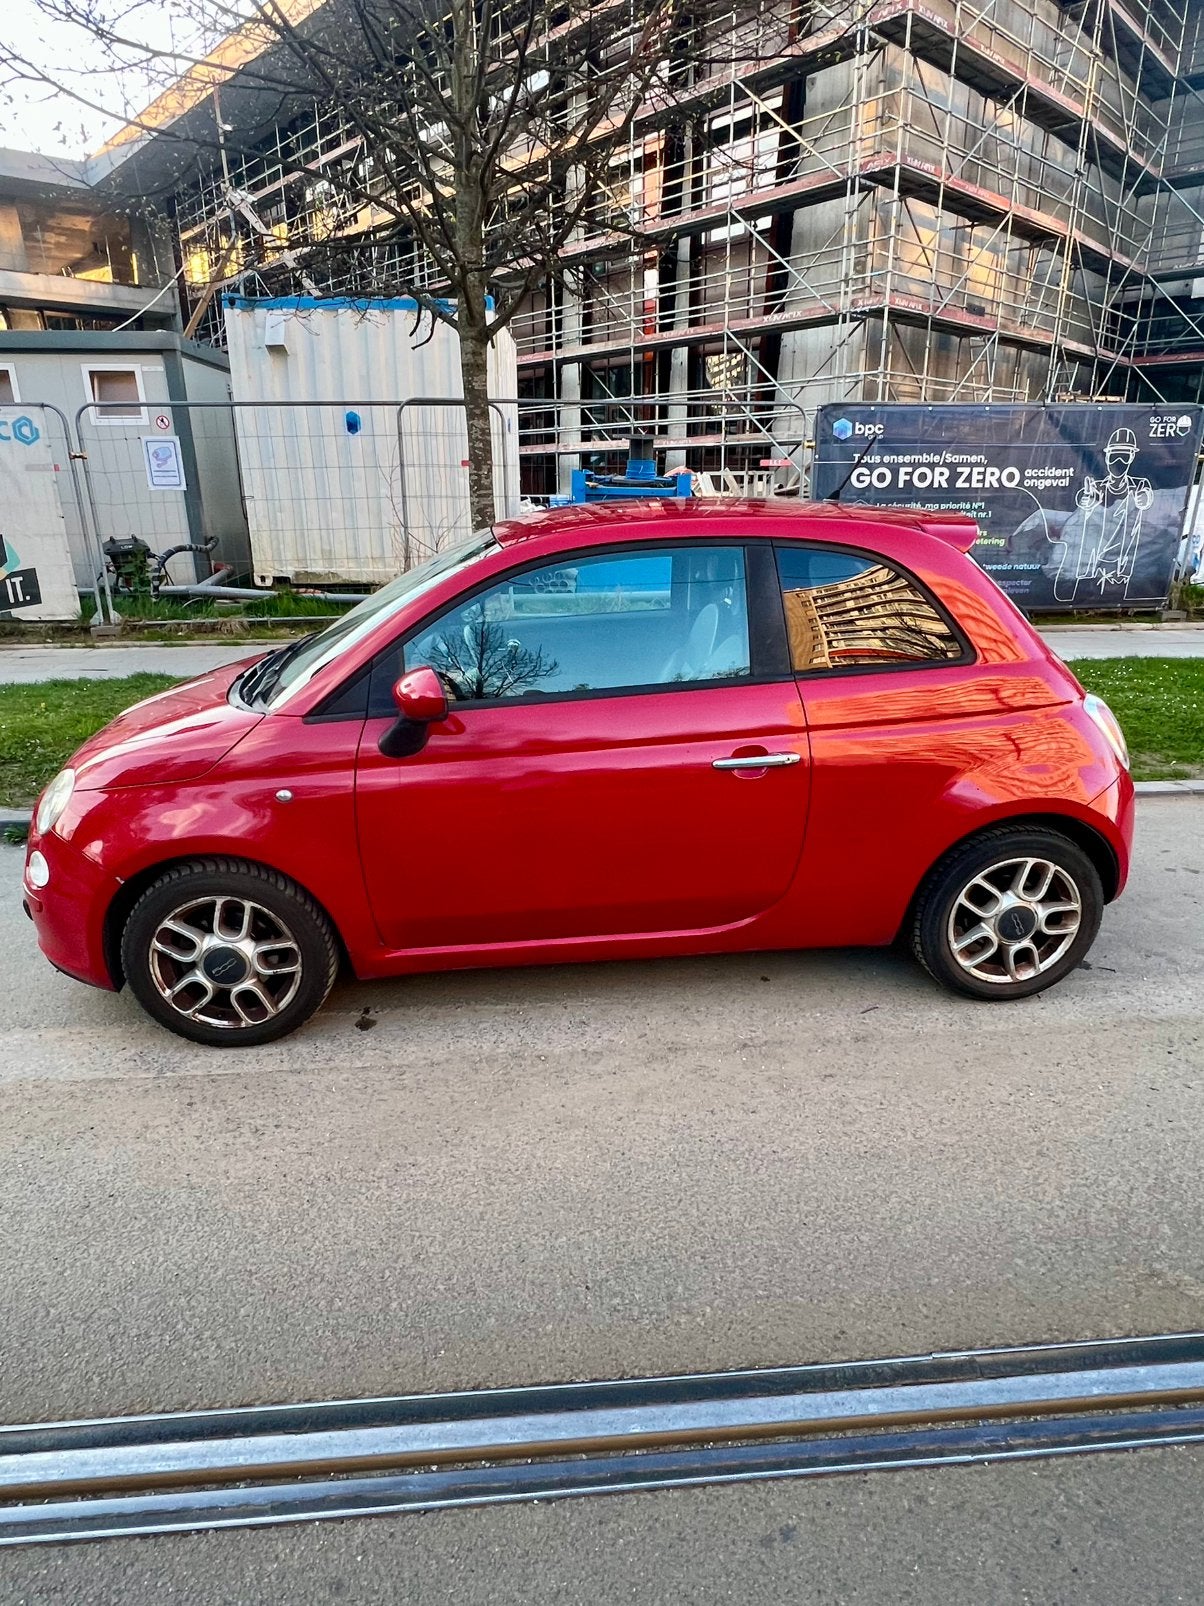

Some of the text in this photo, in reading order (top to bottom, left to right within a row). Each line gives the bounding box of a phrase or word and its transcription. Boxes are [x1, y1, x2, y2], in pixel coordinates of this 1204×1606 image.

[854, 421, 884, 437] bpc
[850, 466, 1075, 489] GO FOR ZERO accident
[1023, 476, 1070, 490] ongeval
[5, 576, 31, 604] IT.
